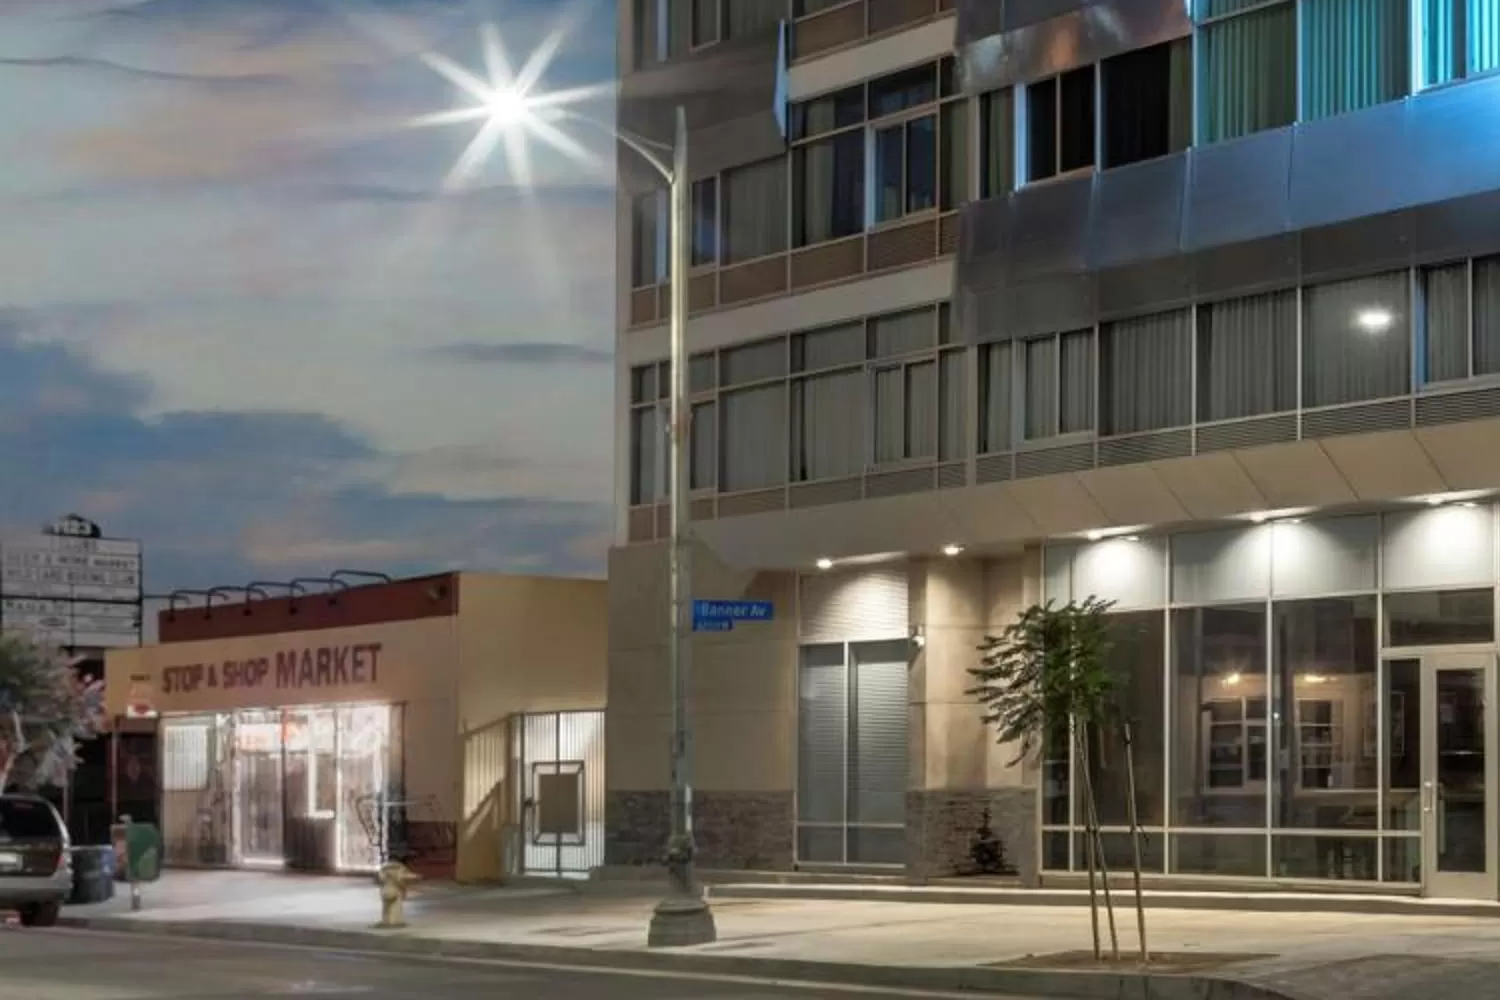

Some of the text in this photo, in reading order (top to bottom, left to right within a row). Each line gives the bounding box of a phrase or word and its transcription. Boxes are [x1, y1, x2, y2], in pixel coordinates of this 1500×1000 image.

[161, 663, 205, 694] STOP
[222, 657, 270, 689] SHOP
[275, 642, 383, 689] MARKET
